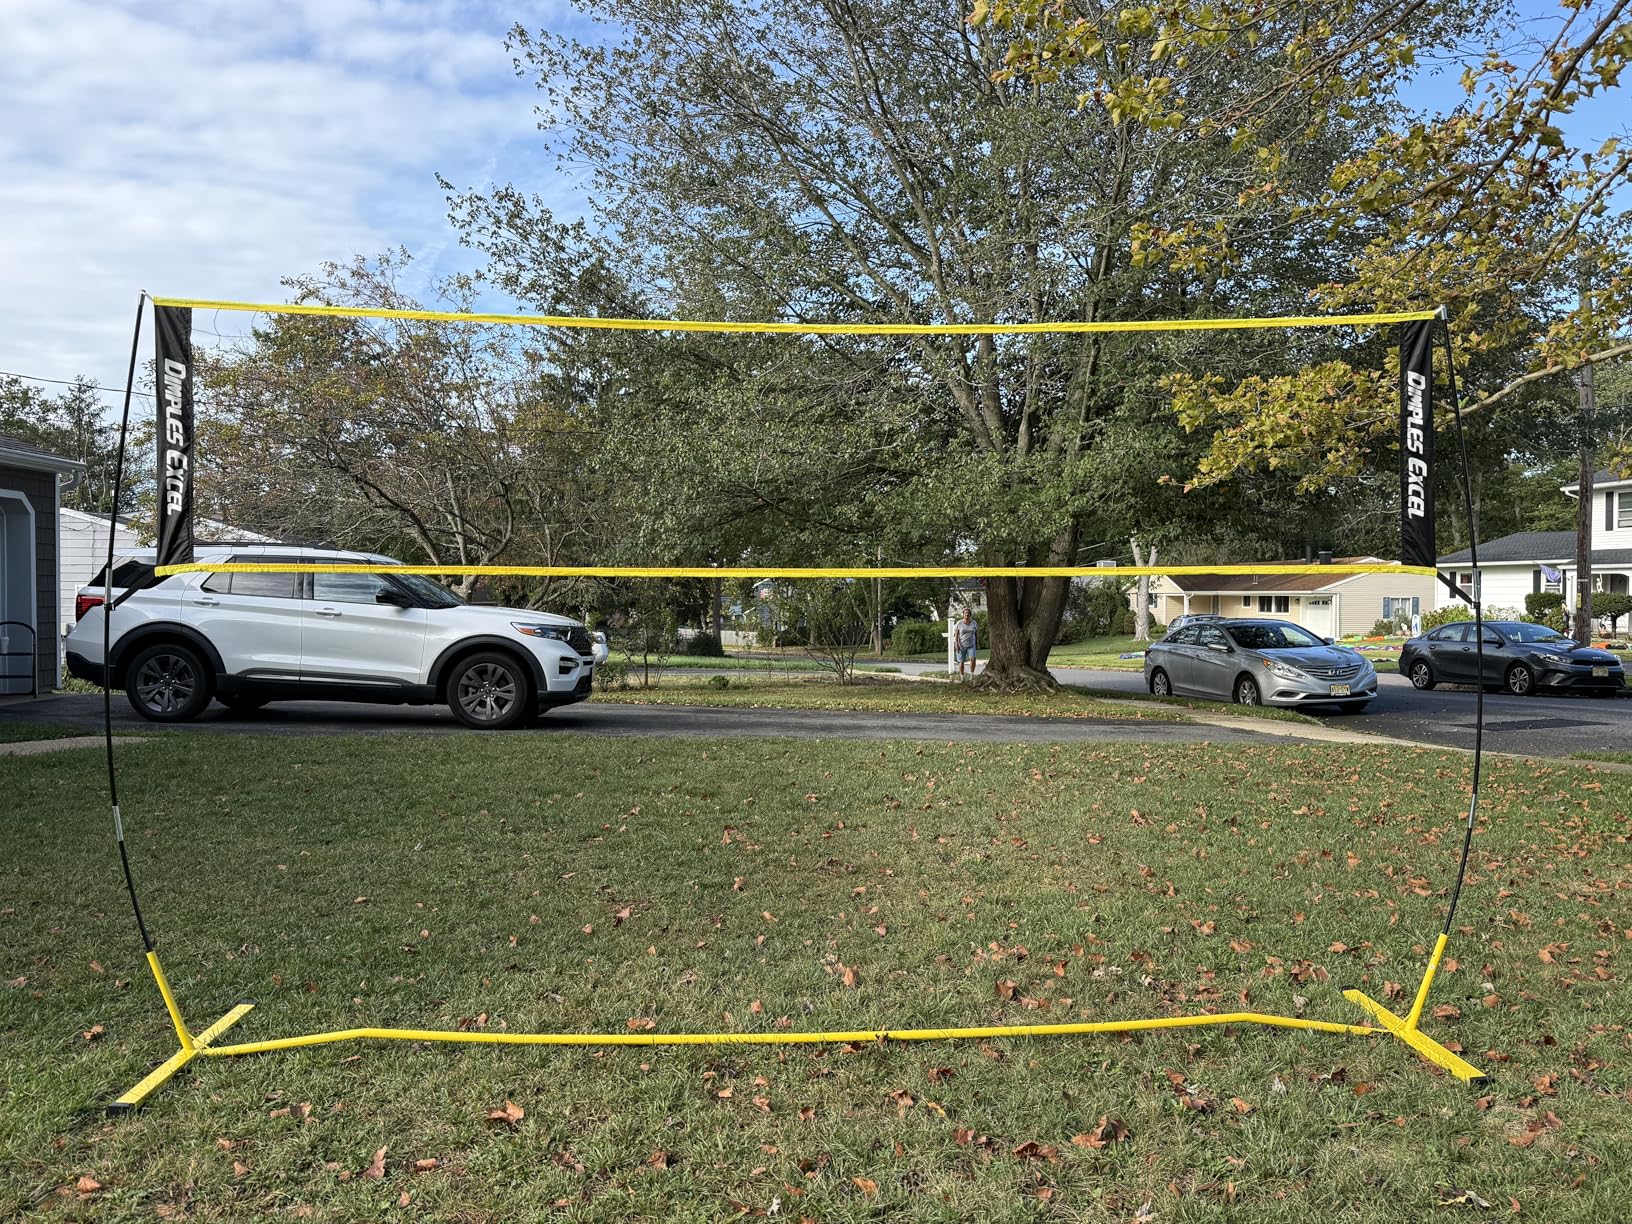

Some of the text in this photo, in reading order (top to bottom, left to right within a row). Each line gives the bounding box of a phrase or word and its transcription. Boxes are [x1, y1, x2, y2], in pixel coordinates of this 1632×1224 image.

[164, 358, 188, 516] DIMPLES EXCEL
[1407, 371, 1428, 519] DIMPLES EXCEL
